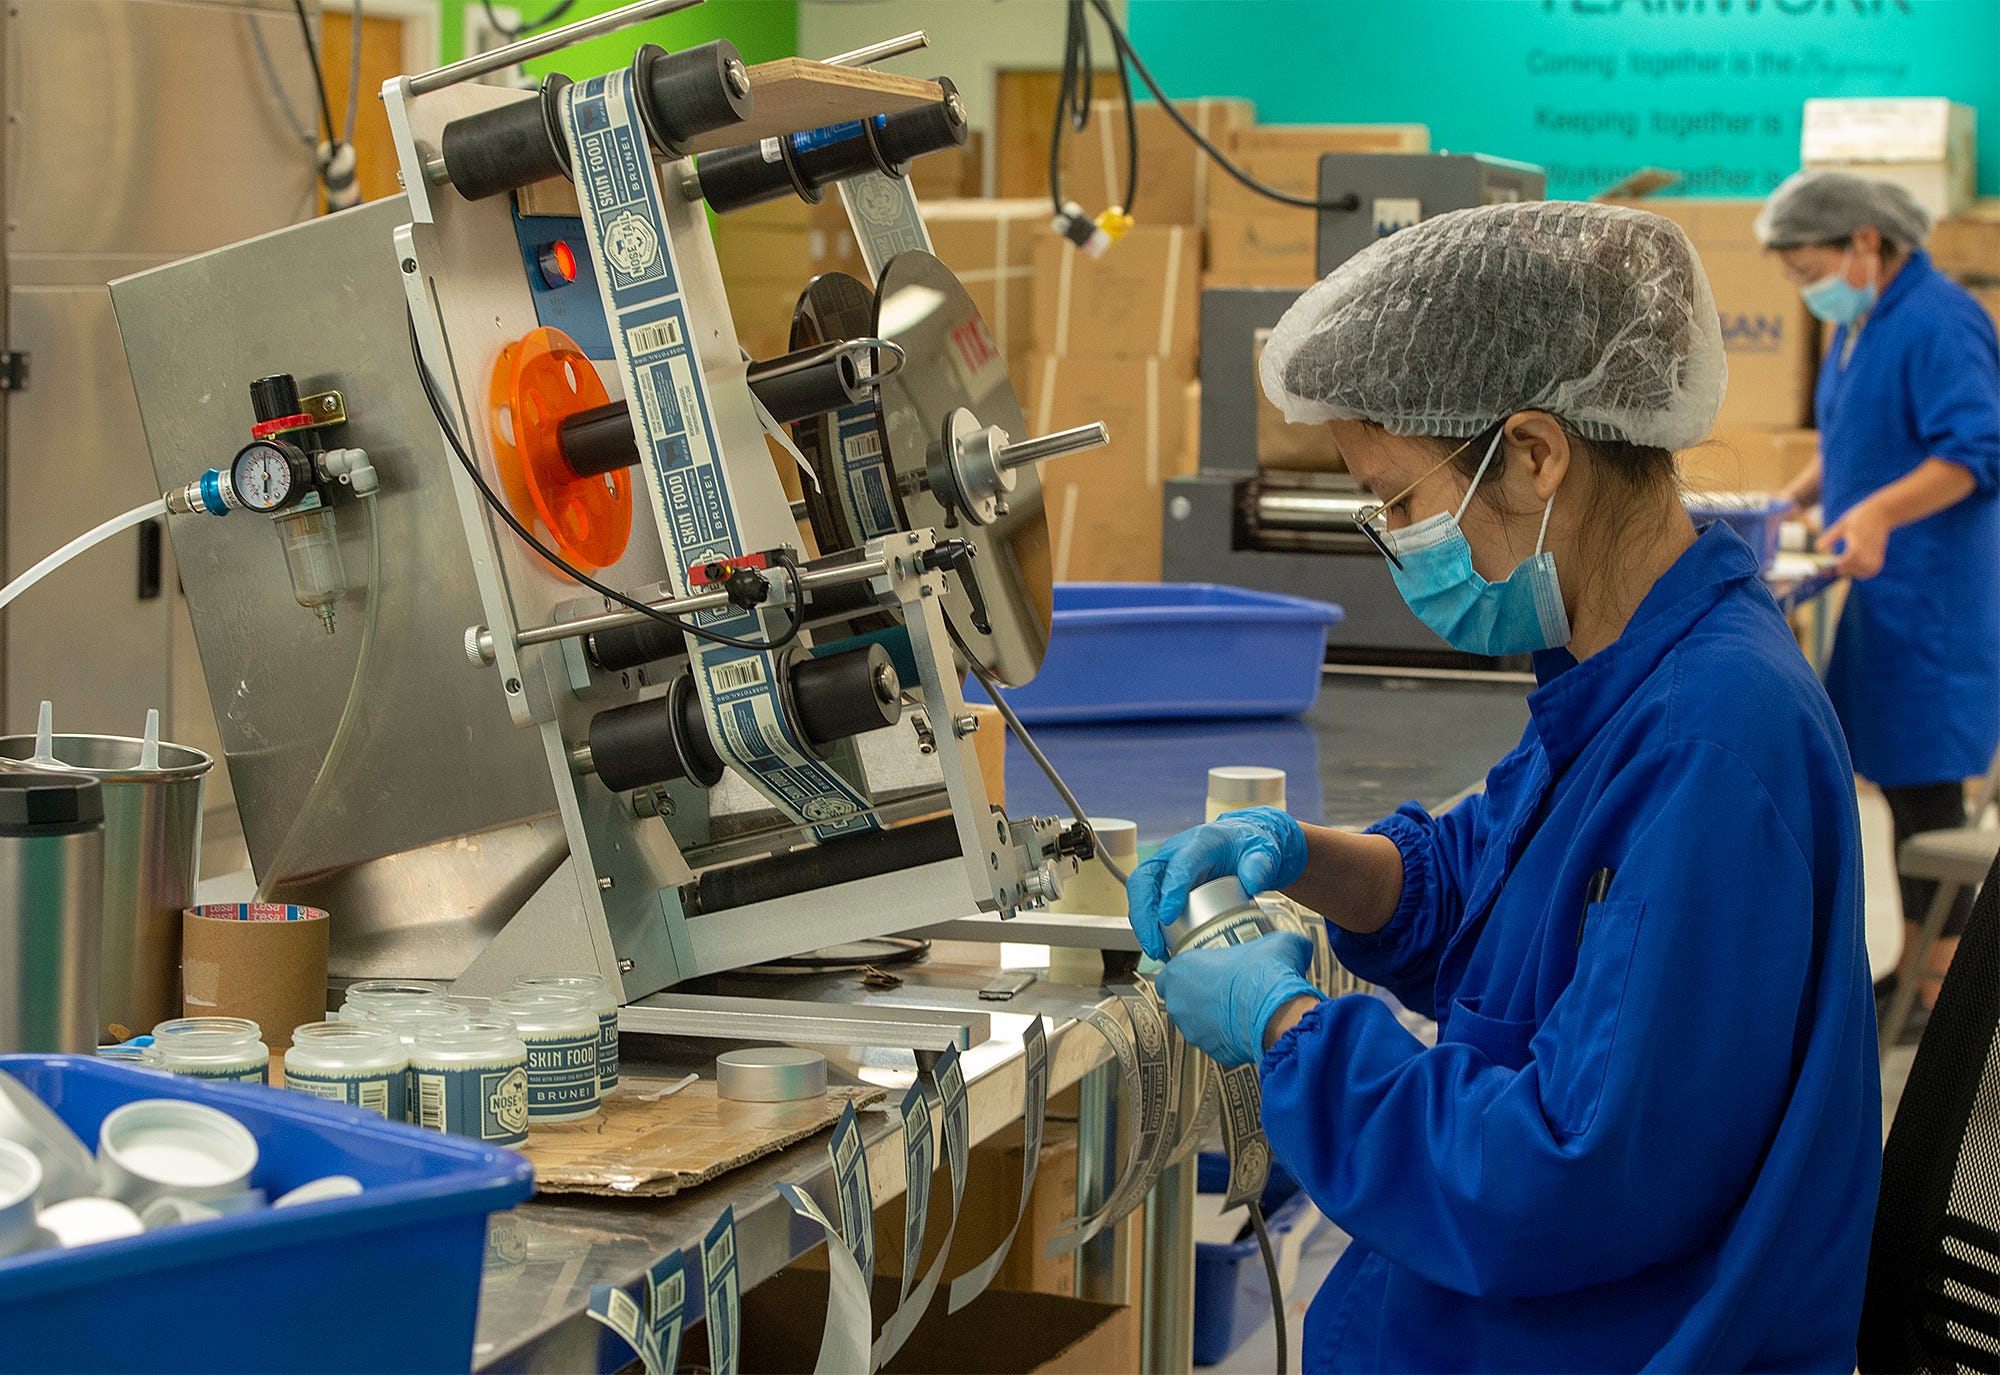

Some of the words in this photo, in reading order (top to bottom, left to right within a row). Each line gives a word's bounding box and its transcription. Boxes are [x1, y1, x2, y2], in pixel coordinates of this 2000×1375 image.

[1534, 105, 1639, 140] Keeping
[1650, 107, 1753, 141] together
[586, 138, 605, 172] FOOD
[620, 137, 640, 191] BRUNEI
[595, 175, 613, 206] SKIN
[620, 213, 633, 239] TAIL
[627, 245, 643, 275] NOSE
[669, 475, 688, 510] FOOD
[703, 475, 722, 529] BRUNEI
[678, 513, 696, 544] SKIN
[529, 1051, 562, 1068] SKIN
[567, 1046, 594, 1066] FOOD
[493, 1095, 517, 1109] NOSE
[537, 1087, 590, 1100] BRUNEI
